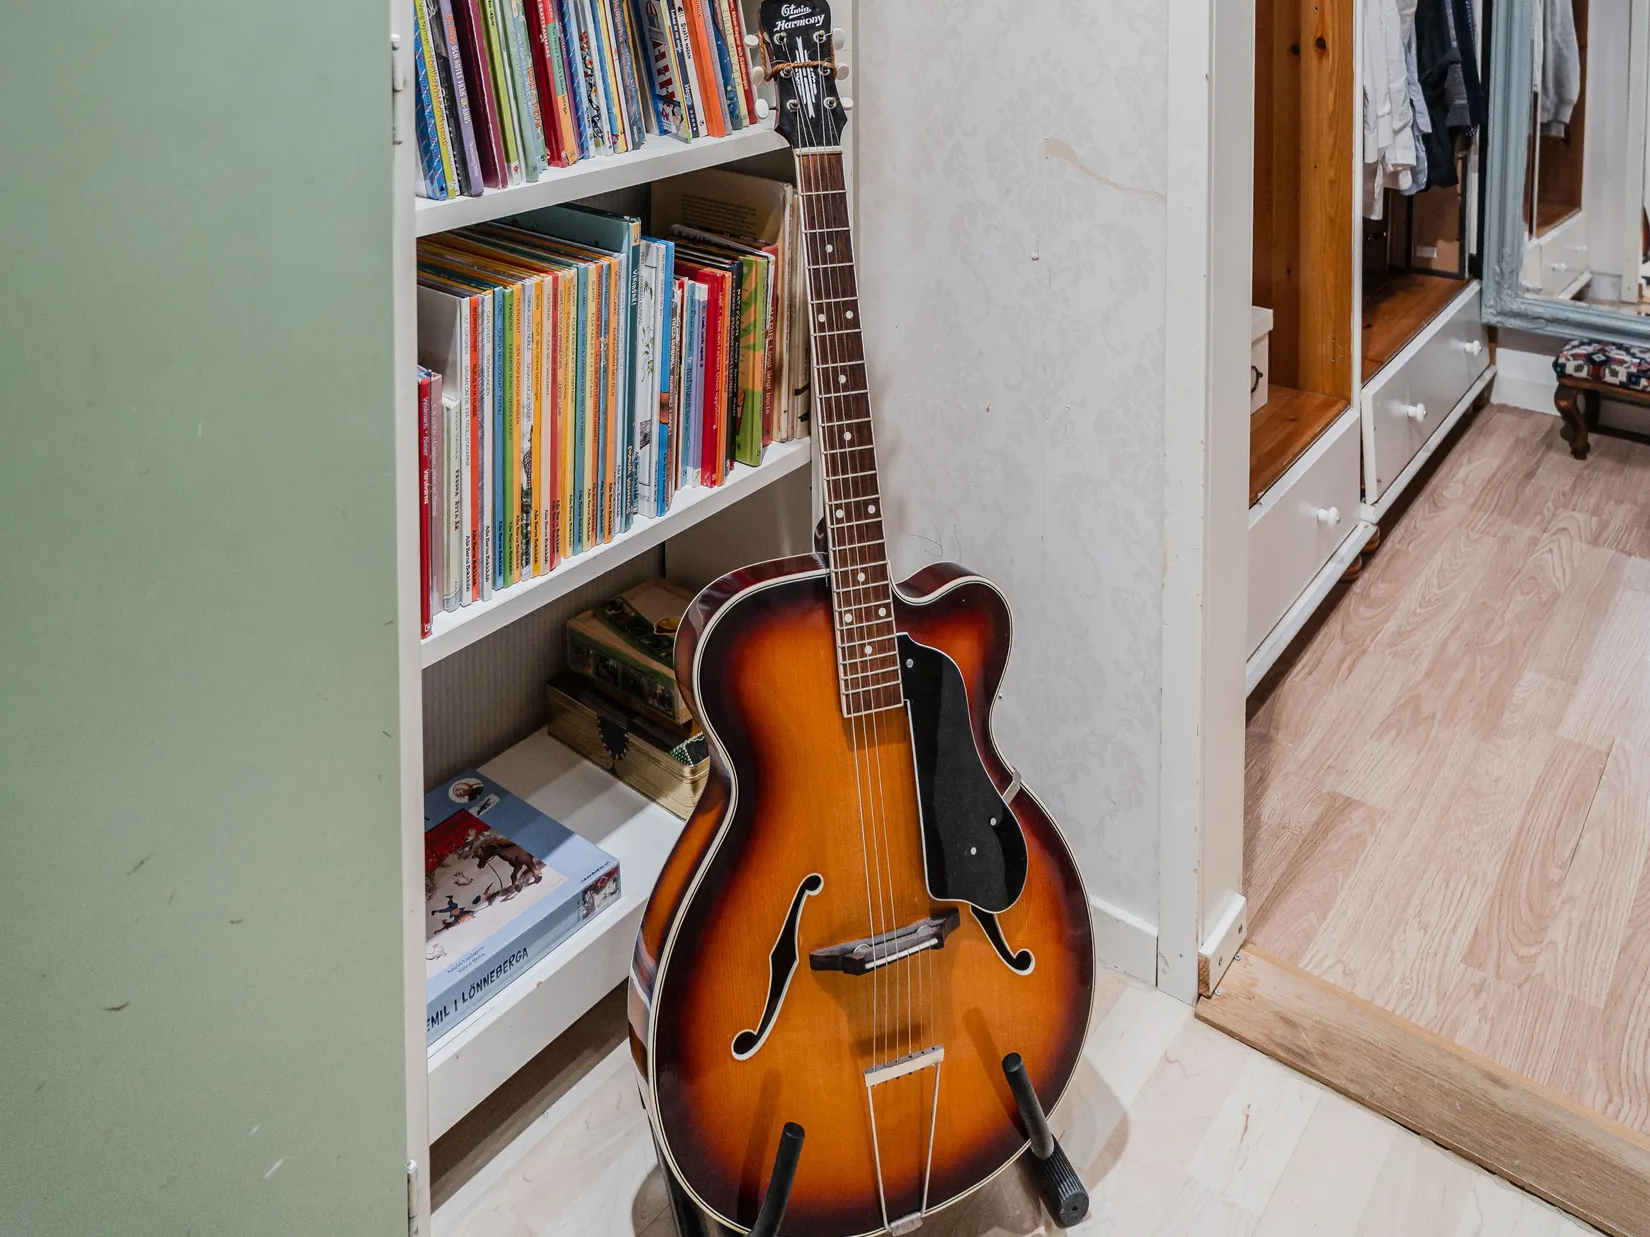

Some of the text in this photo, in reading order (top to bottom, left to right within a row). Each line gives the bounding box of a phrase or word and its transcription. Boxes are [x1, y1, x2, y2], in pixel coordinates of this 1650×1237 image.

[419, 21, 431, 46] Nyman
[537, 3, 551, 59] SKATTKAMMARE
[721, 8, 733, 38] ZIGGE
[728, 42, 737, 59] MED
[773, 14, 825, 32] Harmony
[680, 22, 692, 60] SVARTA MADAM
[730, 11, 750, 90] Atom-Ragnar Gäddkungen
[450, 46, 460, 59] OCH
[453, 60, 464, 79] HOTET
[456, 80, 467, 97] FRÅN
[765, 345, 773, 367] Långt
[464, 386, 469, 396] OM
[764, 370, 772, 390] långt
[427, 946, 529, 1032] EMIL I LÖNNEBERGA
